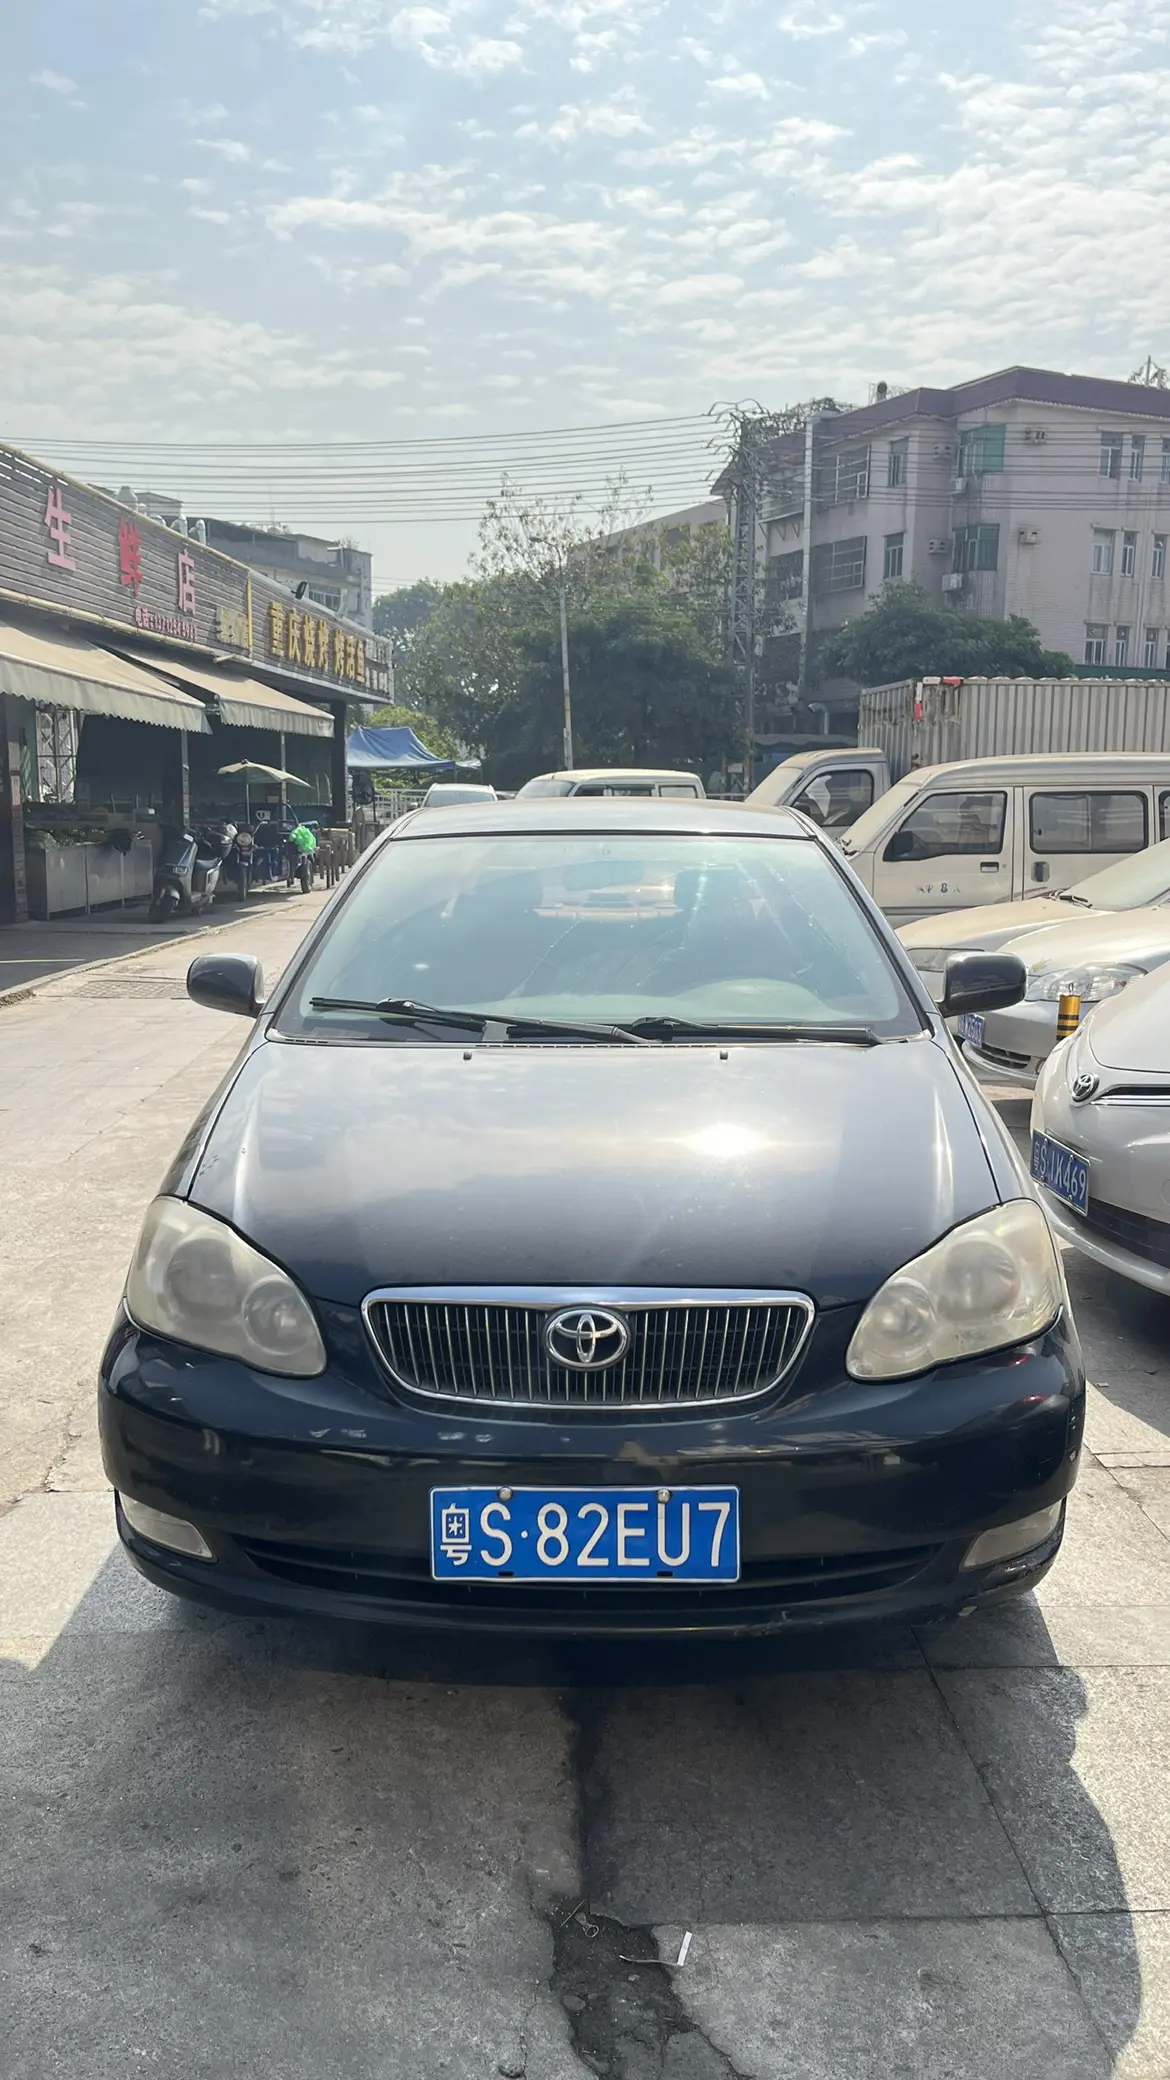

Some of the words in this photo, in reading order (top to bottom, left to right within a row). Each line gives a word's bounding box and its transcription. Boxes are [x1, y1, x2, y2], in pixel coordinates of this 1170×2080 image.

[44, 487, 196, 616] 生鲜店
[440, 1502, 731, 1567] 粤S·82EU7
